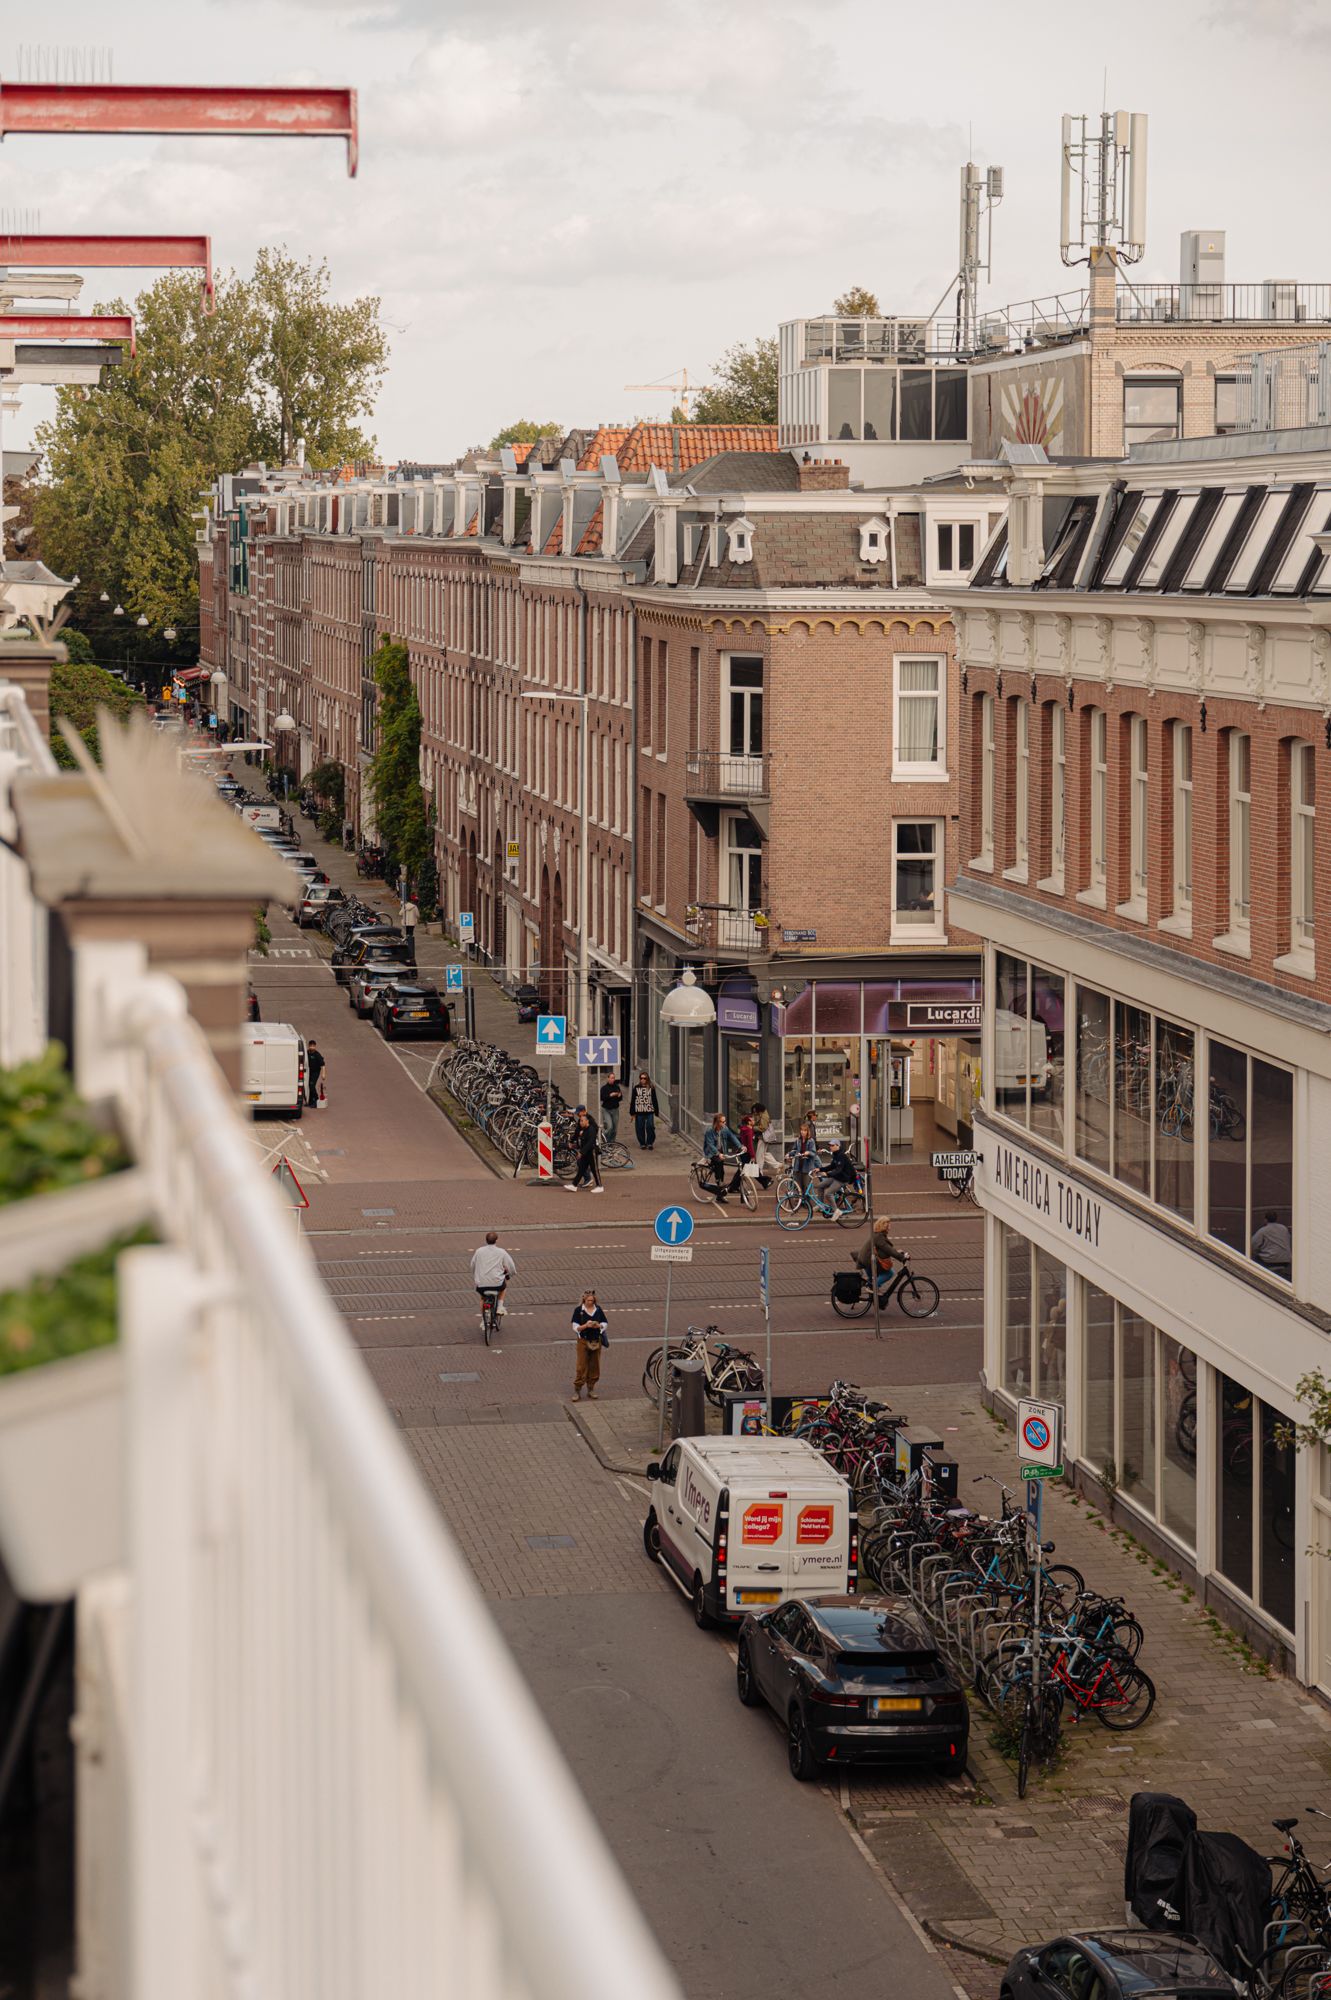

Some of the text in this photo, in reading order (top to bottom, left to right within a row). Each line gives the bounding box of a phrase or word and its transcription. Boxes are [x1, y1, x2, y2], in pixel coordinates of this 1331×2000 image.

[463, 915, 470, 926] P
[450, 968, 459, 979] P
[927, 1006, 980, 1019] Lucardi
[935, 1154, 976, 1165] AMERICA
[942, 1168, 967, 1179] TODAY
[996, 1145, 1100, 1247] AMERICA TODAY
[1028, 1406, 1046, 1416] ZONE
[685, 1466, 710, 1523] Ymere
[768, 1516, 782, 1524] mijn
[744, 1523, 770, 1531] collega?
[802, 1554, 843, 1565] ymere.nl
